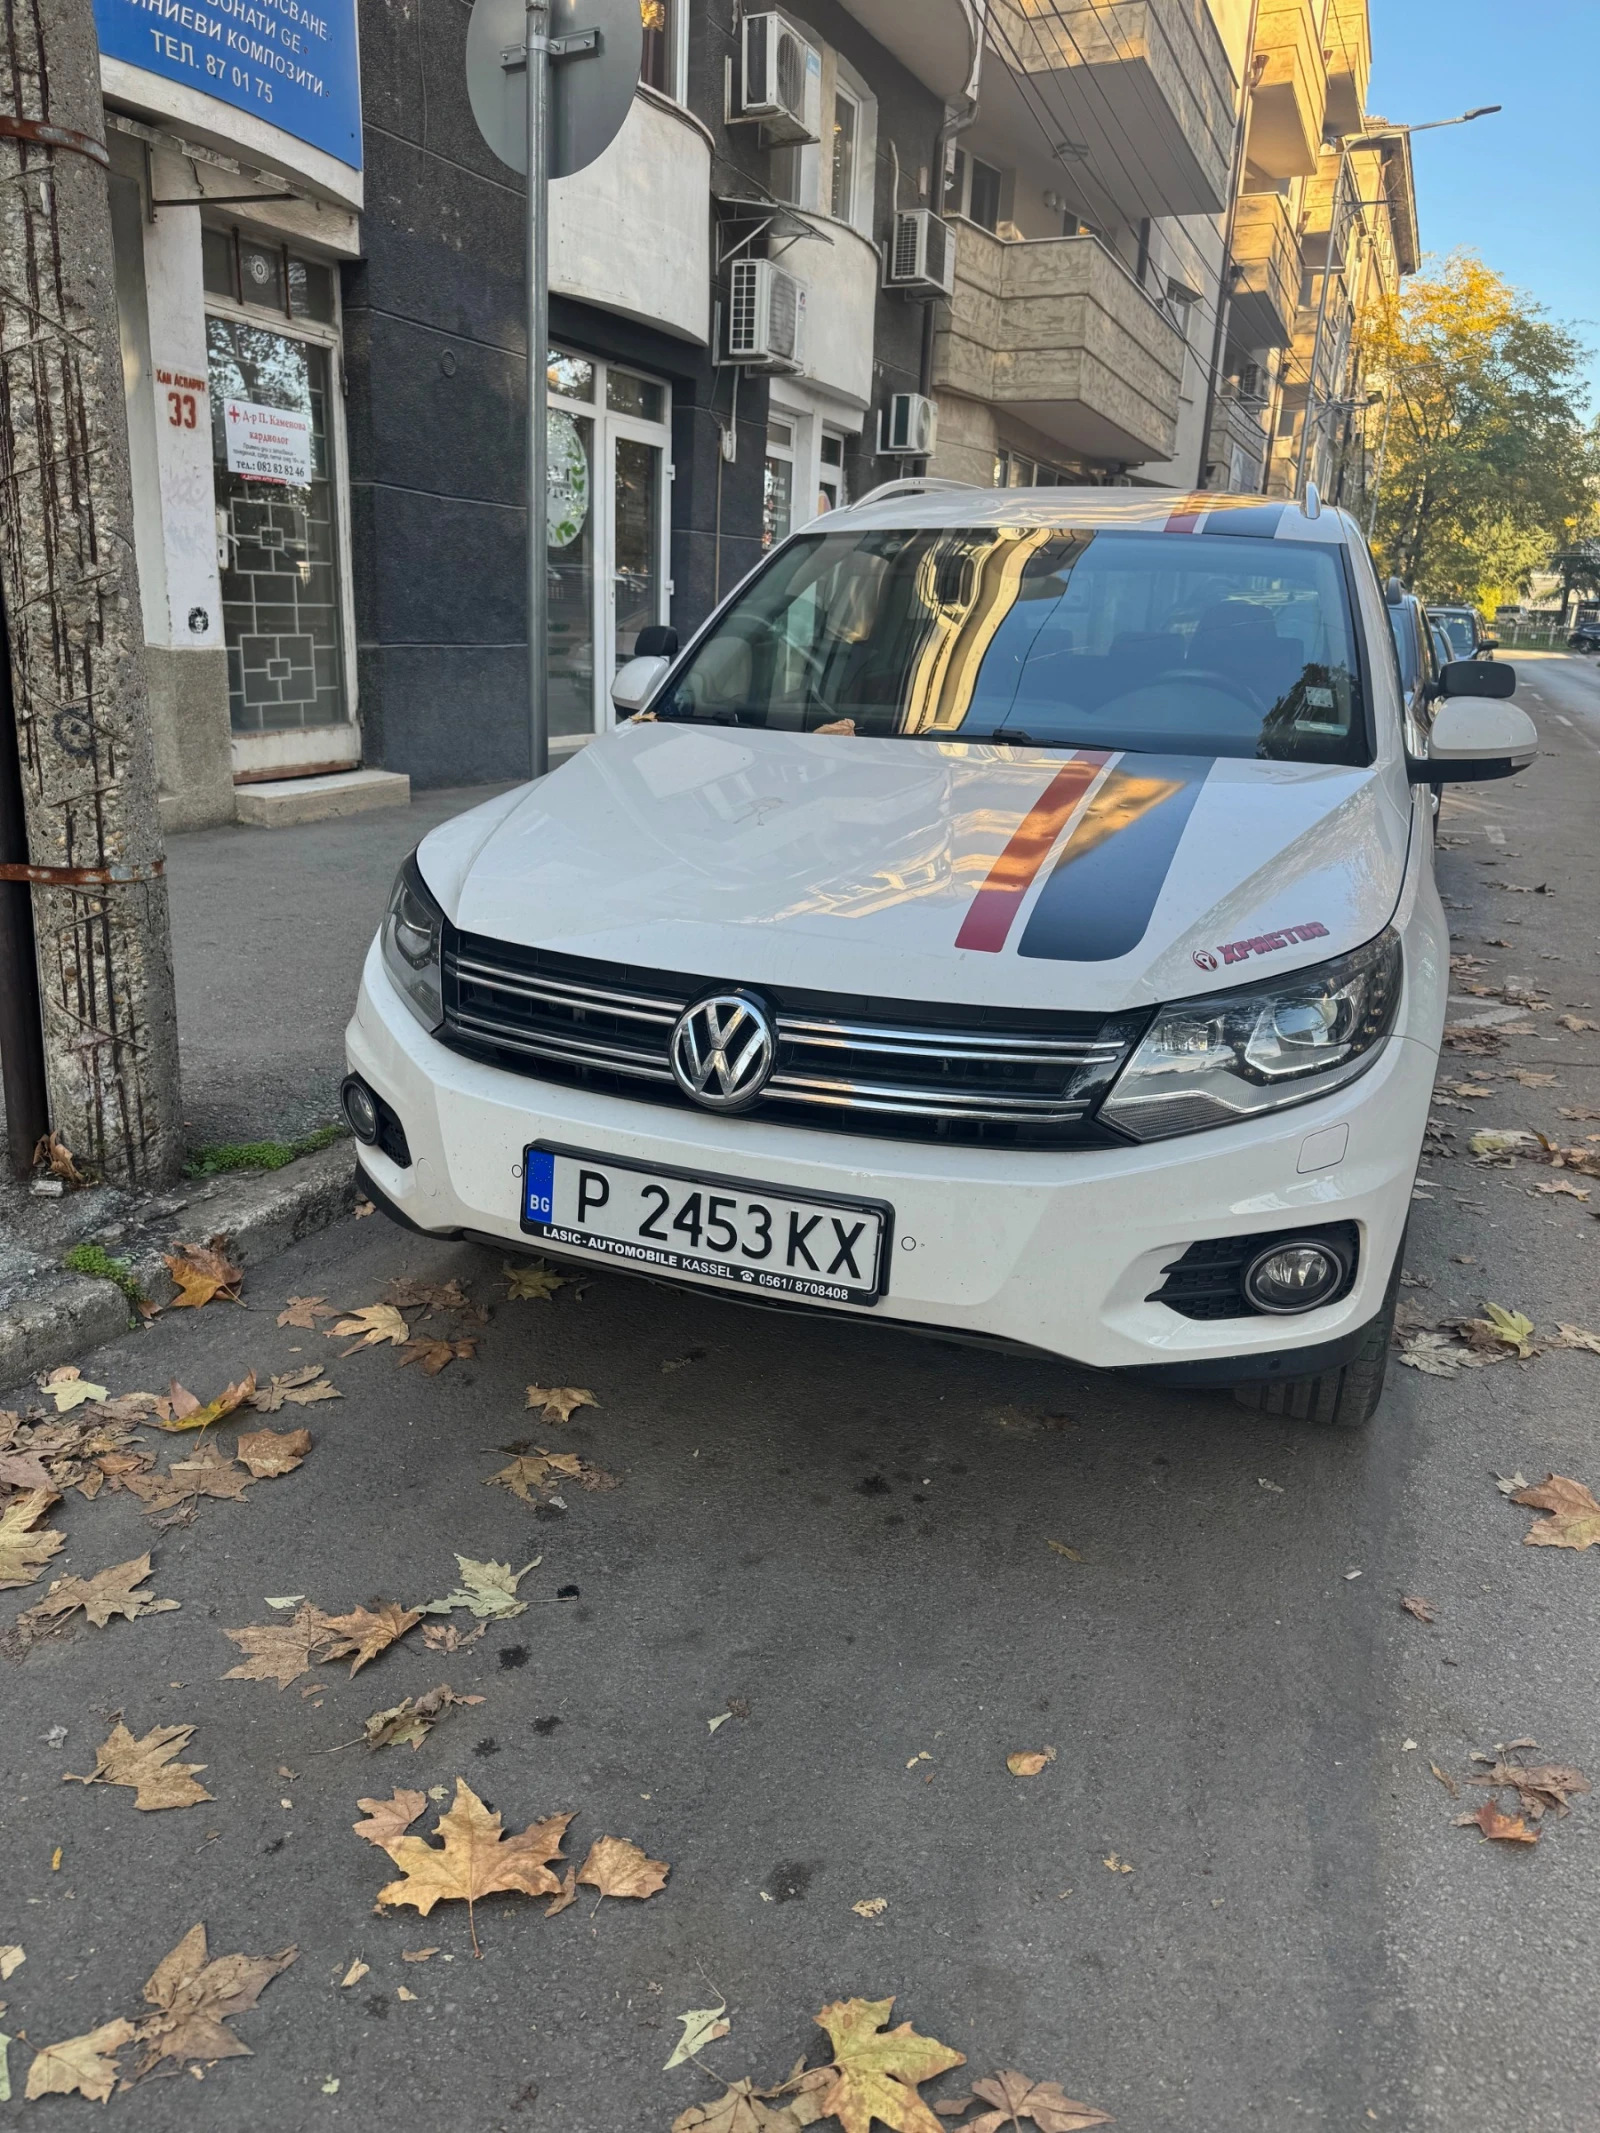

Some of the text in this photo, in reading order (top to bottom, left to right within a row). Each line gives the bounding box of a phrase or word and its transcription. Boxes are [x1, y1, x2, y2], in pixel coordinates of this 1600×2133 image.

[206, 0, 301, 54] ОНАТИ GE
[149, 28, 273, 104] ТЕЛ. 87 01 75
[227, 28, 323, 97] КОМПОЗИТИ
[168, 392, 197, 430] 33
[242, 410, 258, 425] Д-р
[269, 414, 307, 431] Каменова
[249, 431, 290, 445] кардиолог
[256, 461, 272, 473] 082
[273, 463, 284, 475] 82
[284, 464, 295, 476] 82
[295, 467, 306, 478] 46
[1217, 921, 1331, 965] ХРИСТОВ
[671, 995, 773, 1107] VW
[530, 1194, 551, 1213] BG
[577, 1169, 866, 1280] P 2453 KX
[682, 1257, 735, 1279] KASSEL
